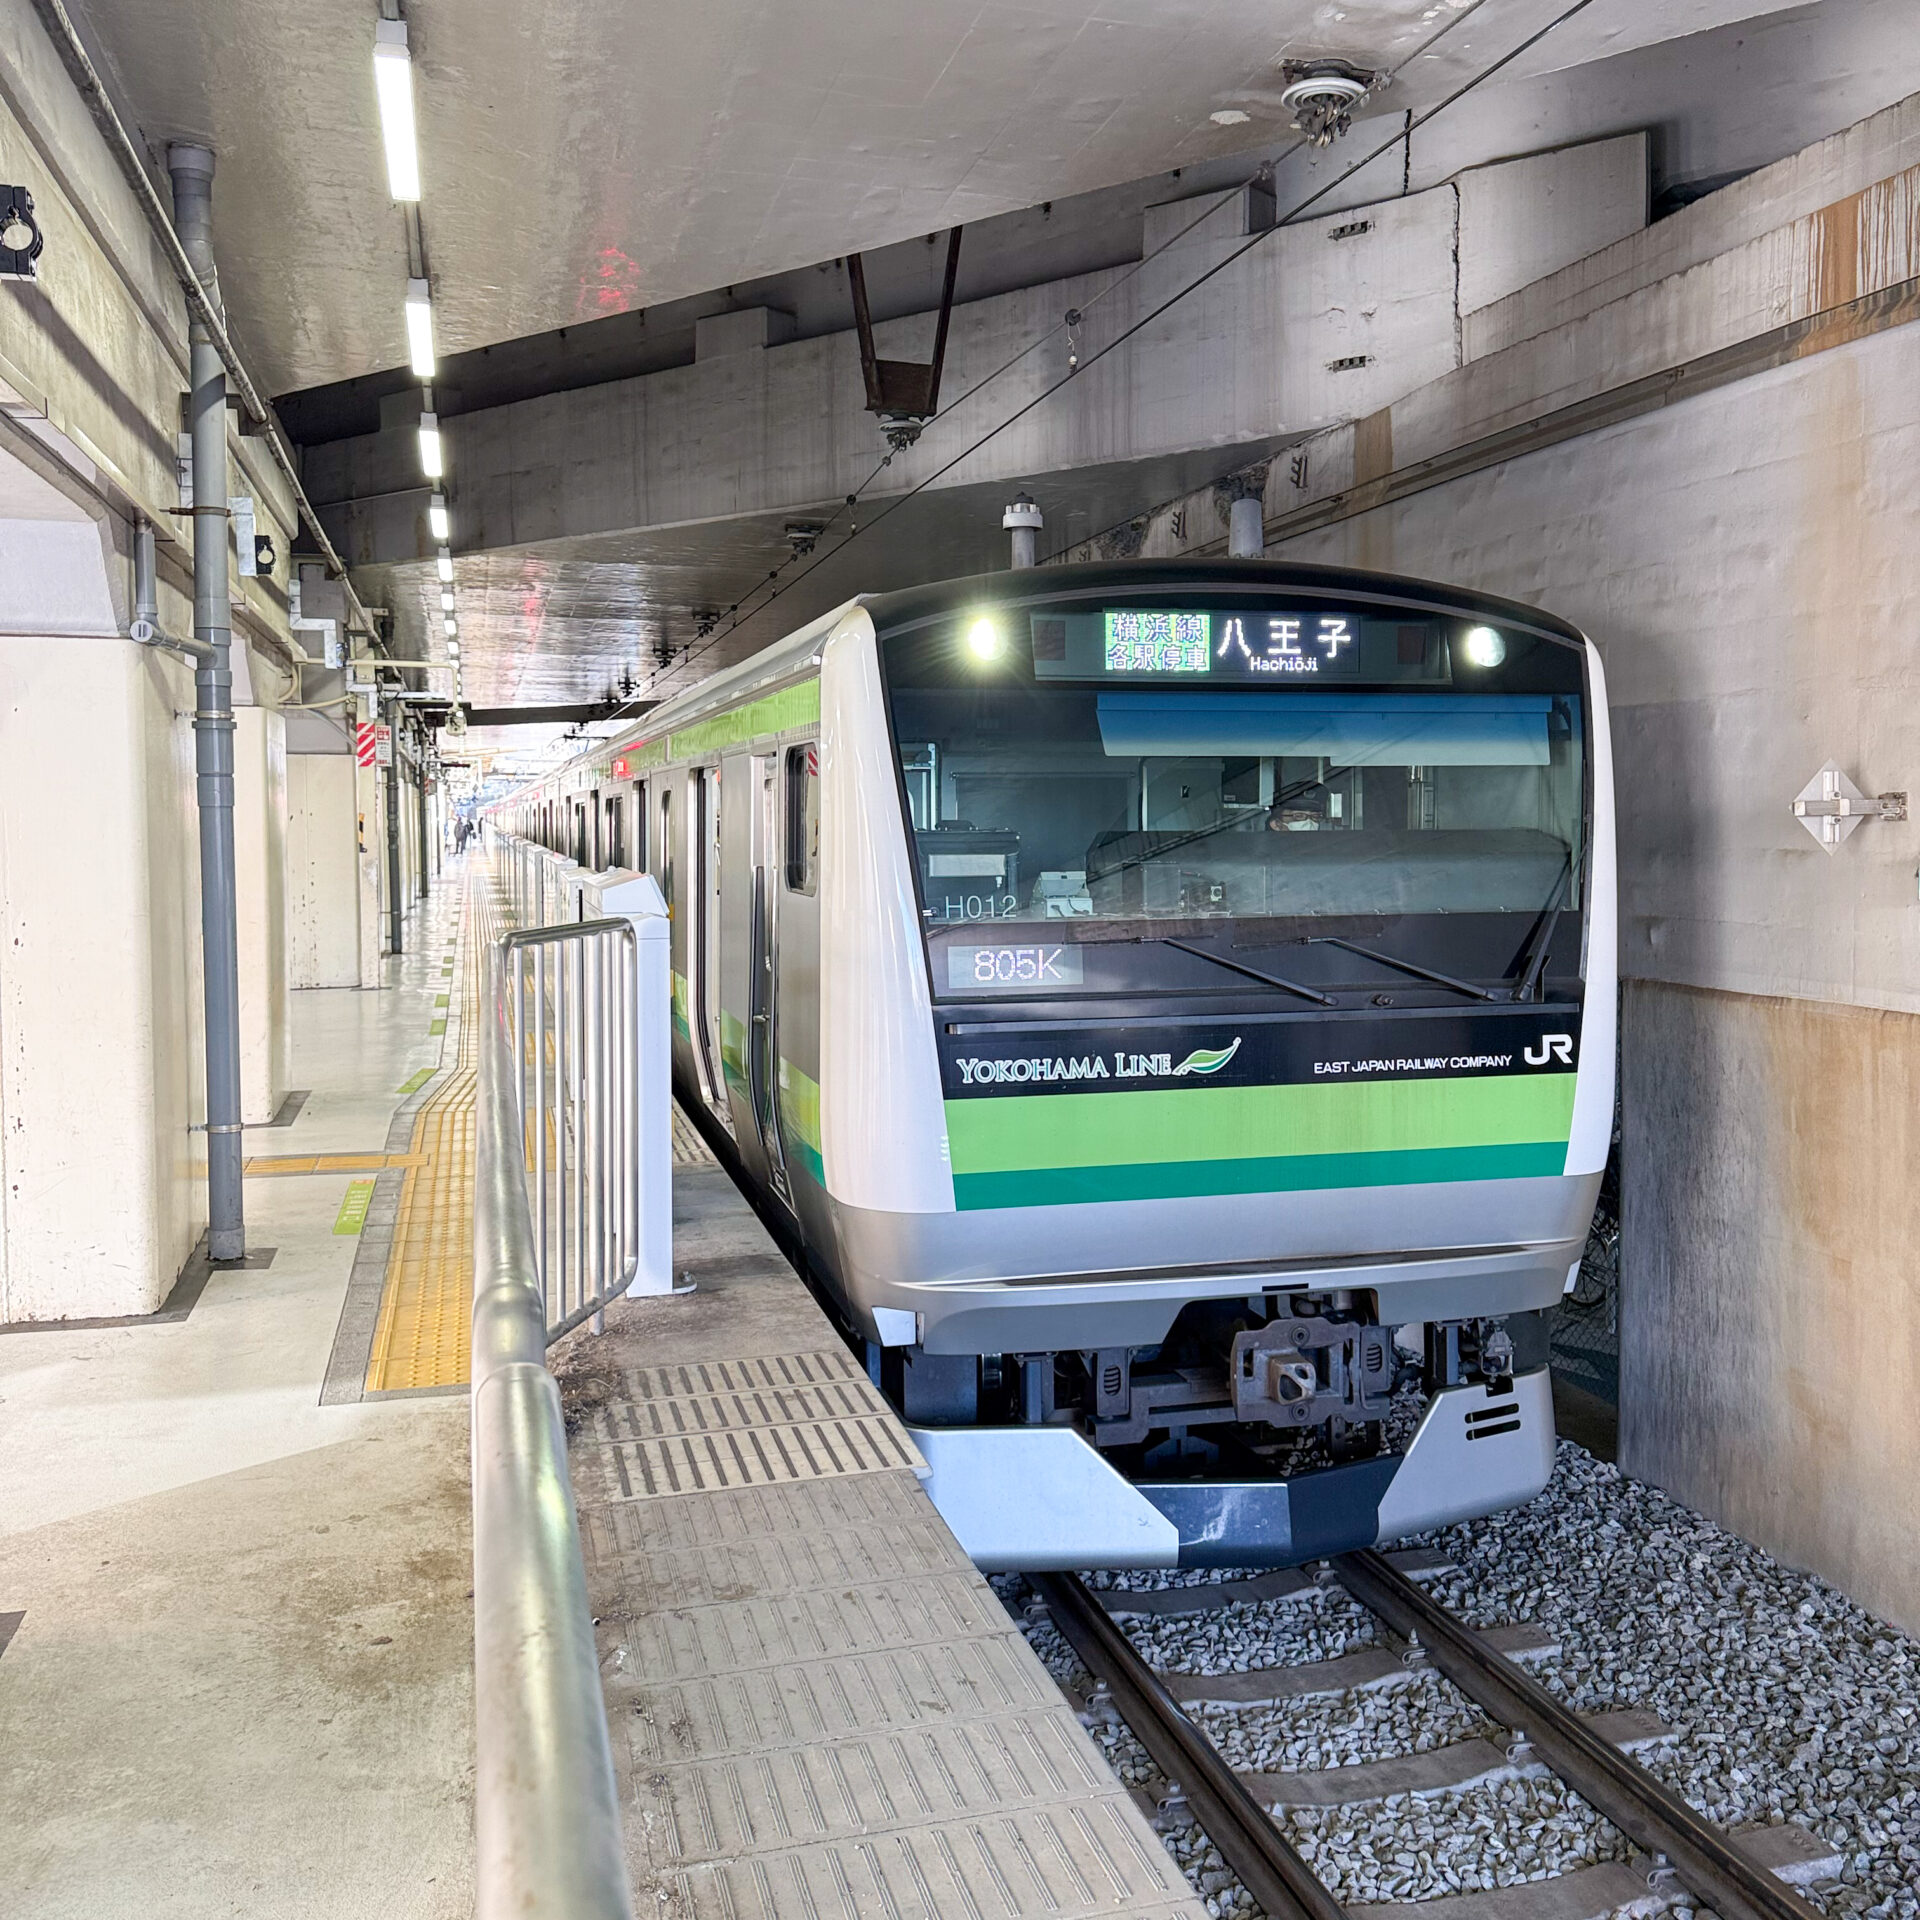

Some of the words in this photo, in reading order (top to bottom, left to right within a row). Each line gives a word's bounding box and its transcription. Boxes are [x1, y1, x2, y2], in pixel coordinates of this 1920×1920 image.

[1113, 614, 1204, 641] 横浜線
[1217, 617, 1351, 657] 八王子
[1107, 643, 1207, 671] 各駅停車
[945, 895, 1017, 919] H012
[973, 948, 1063, 981] 805K
[1314, 1061, 1350, 1074] EAST
[1351, 1058, 1395, 1072] JAPAN
[1396, 1056, 1449, 1071] RAILWAY
[1450, 1054, 1513, 1069] COMPANY
[1523, 1033, 1573, 1066] JR
[957, 1054, 1110, 1084] YOKOHAMA
[1115, 1051, 1172, 1077] LINE
